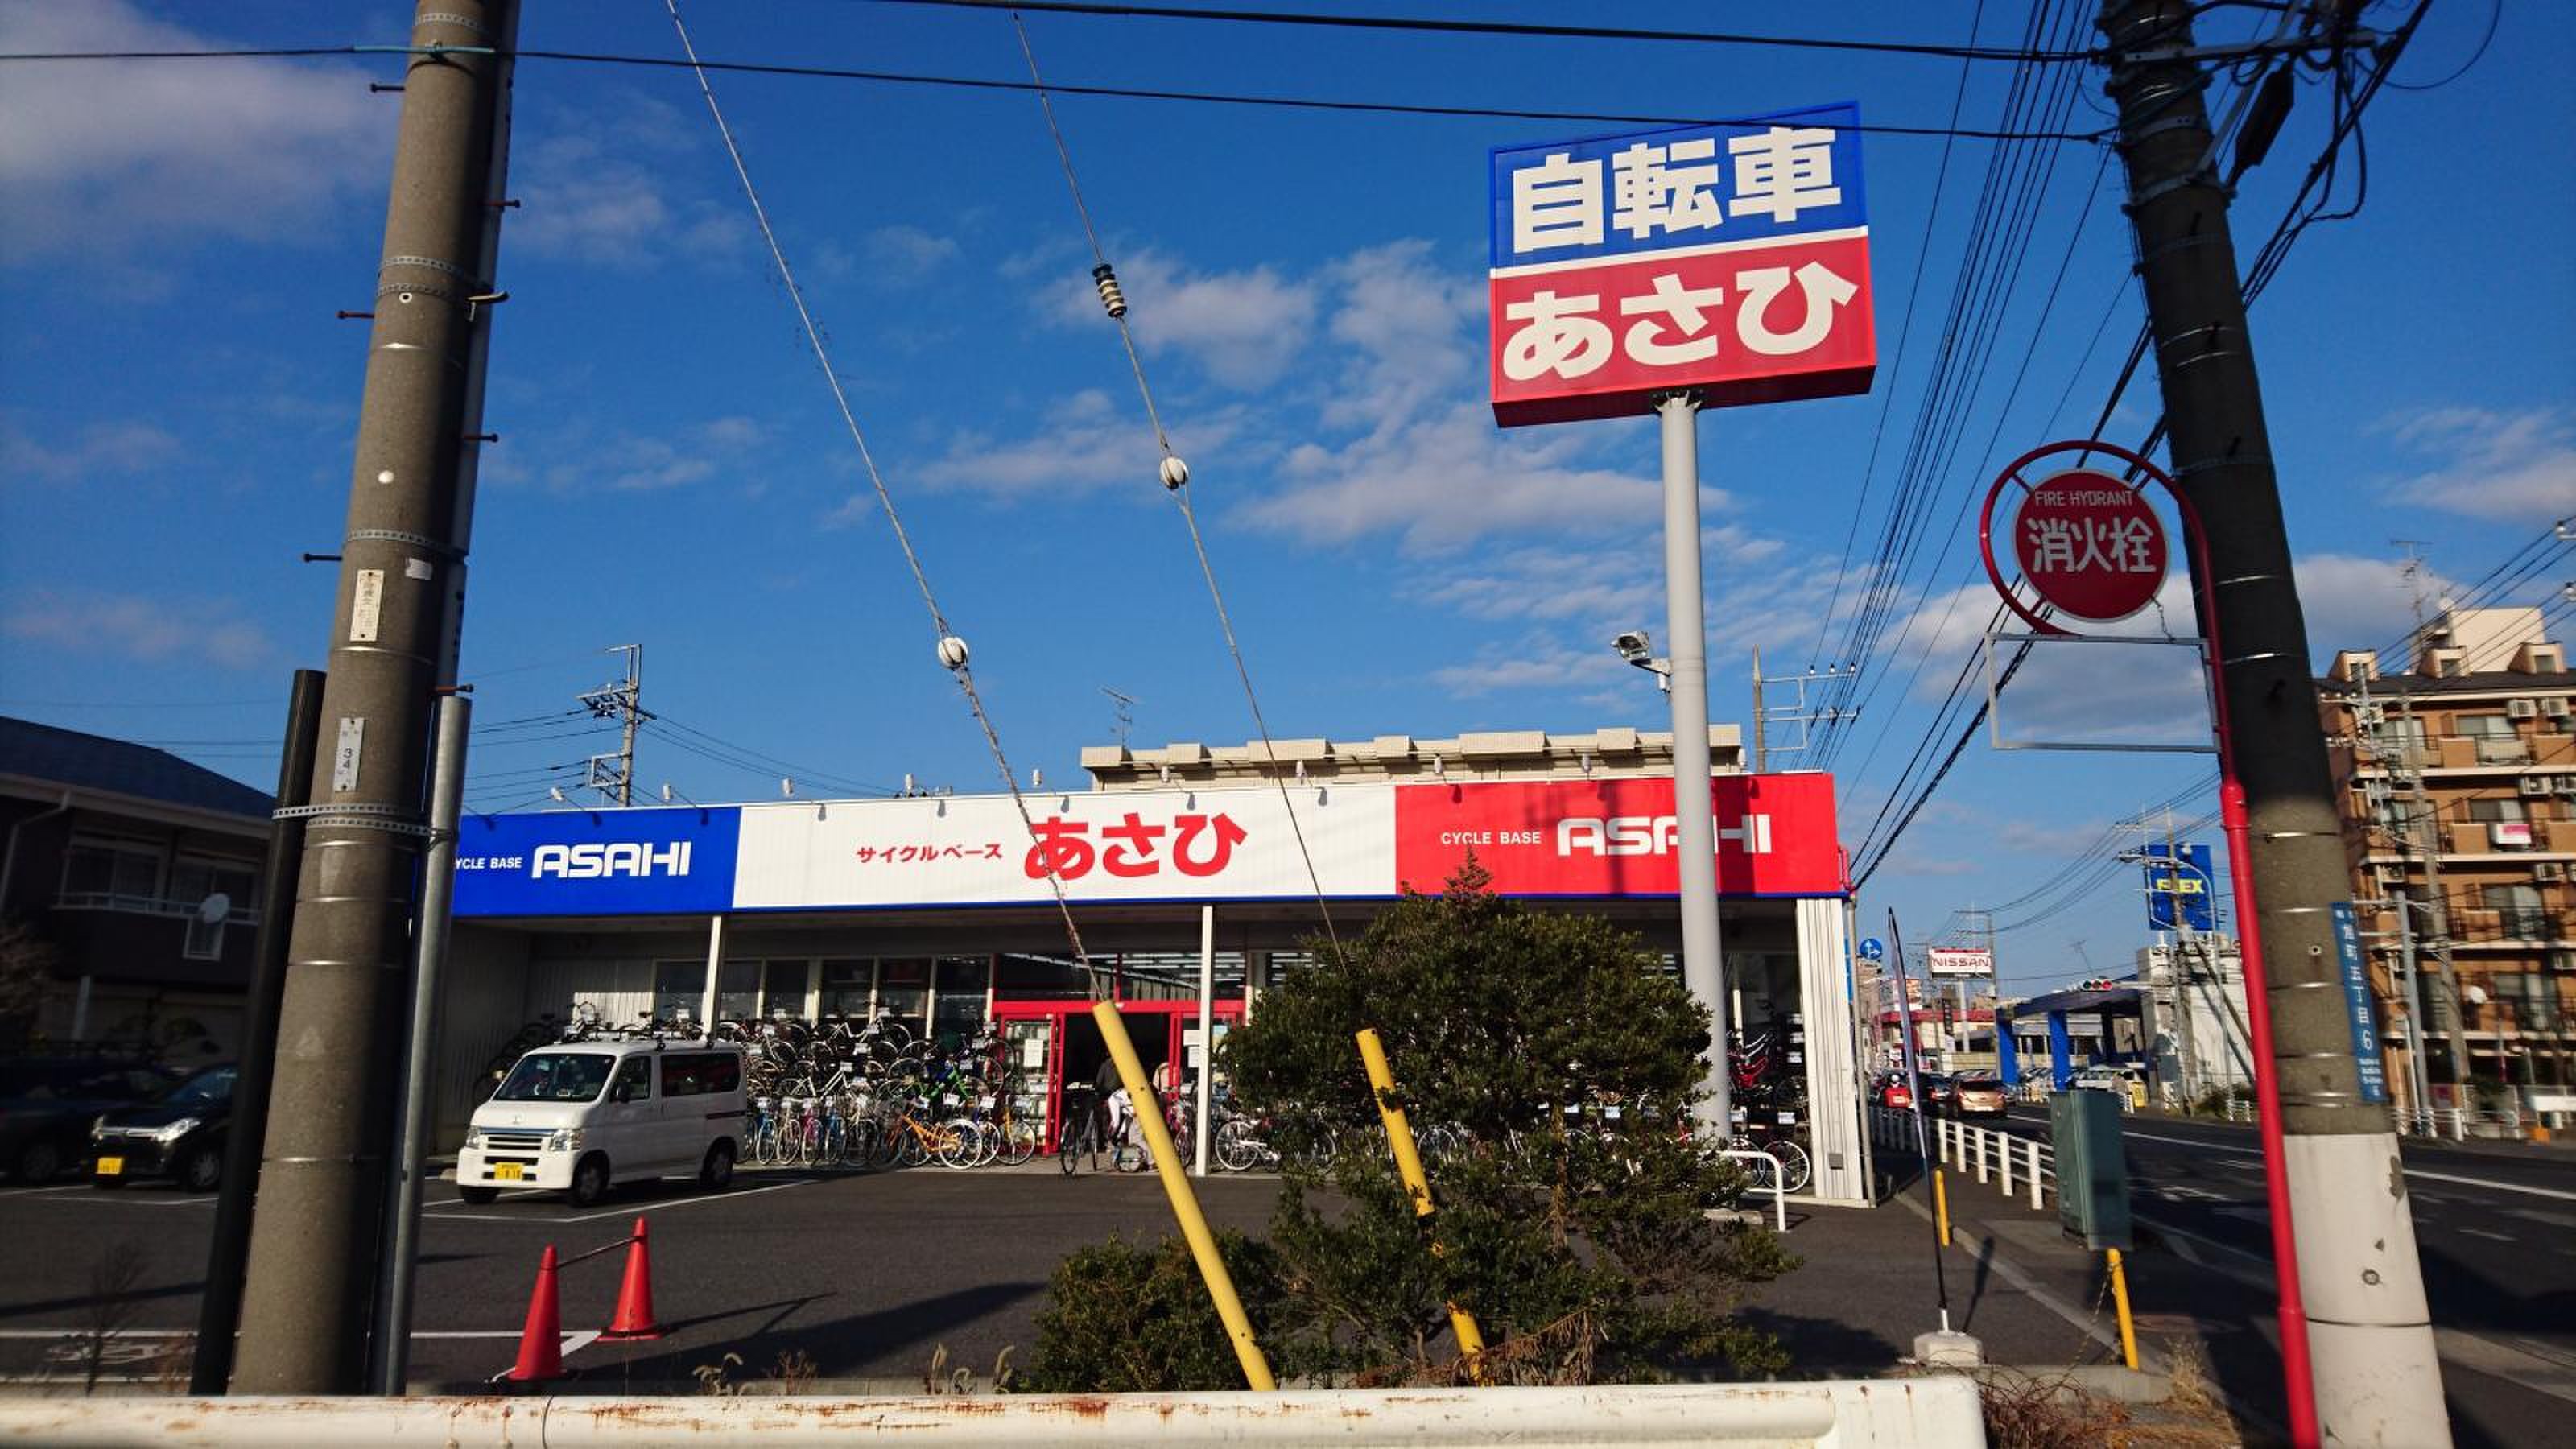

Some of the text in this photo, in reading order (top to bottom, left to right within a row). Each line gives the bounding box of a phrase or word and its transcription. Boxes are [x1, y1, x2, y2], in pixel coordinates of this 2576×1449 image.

[1513, 126, 1842, 254] 自転車
[1502, 261, 1859, 382] あさひ
[2035, 490, 2132, 506] FIRE HYDRANT
[2026, 516, 2157, 573] 消火栓
[857, 812, 1248, 881] サイクルベース あさひ
[1441, 832, 1492, 845] CYCLE
[1500, 832, 1542, 845] BASE
[455, 841, 691, 879] YCLE BASE ASAHI
[2157, 878, 2205, 894] FEX
[1932, 956, 1989, 967] NISSAN
